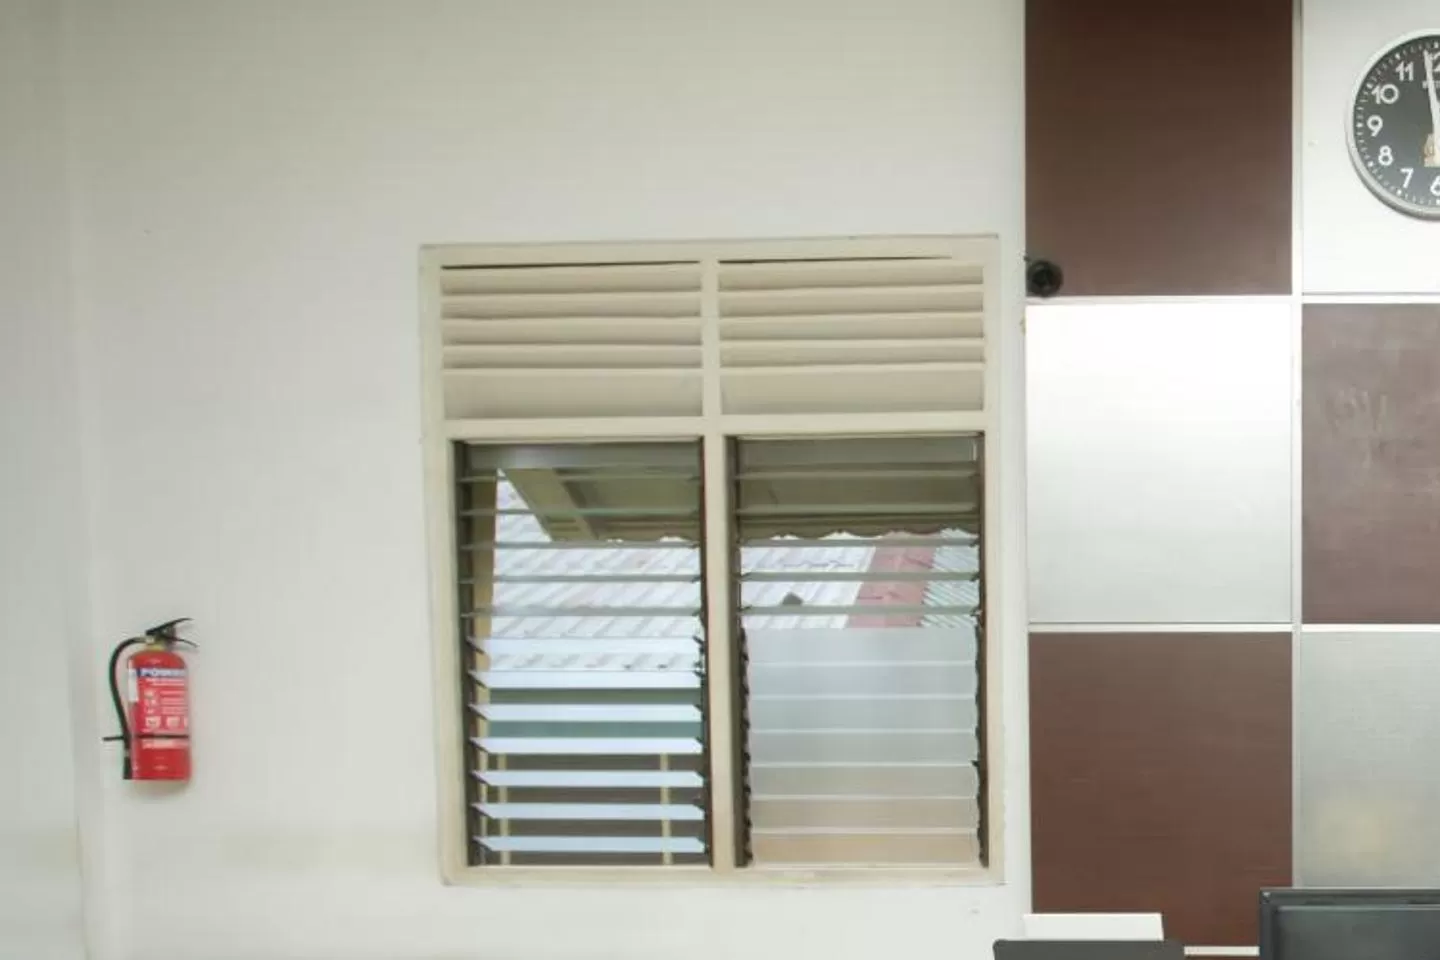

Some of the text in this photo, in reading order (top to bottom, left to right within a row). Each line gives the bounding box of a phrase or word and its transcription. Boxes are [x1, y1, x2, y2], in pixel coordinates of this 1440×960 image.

[1395, 61, 1414, 81] 11
[1371, 83, 1400, 104] 10
[1366, 115, 1383, 137] 9
[1378, 145, 1394, 166] 8
[1400, 167, 1414, 188] 7
